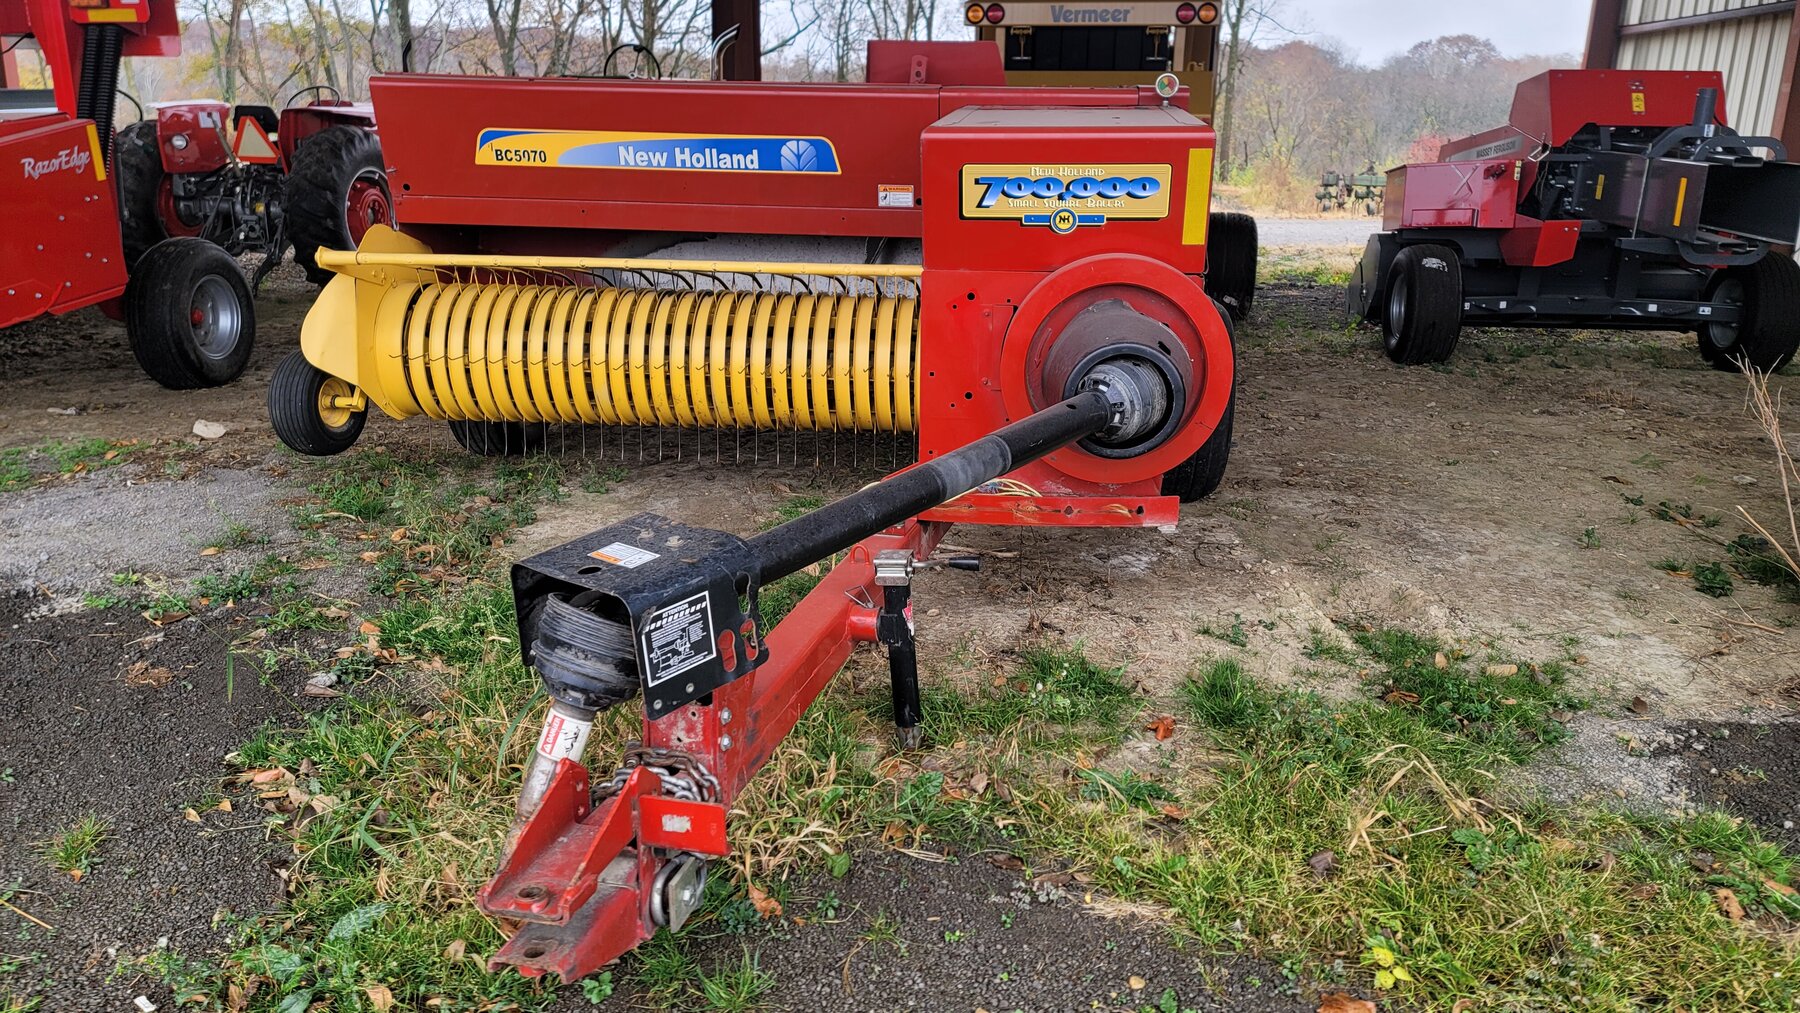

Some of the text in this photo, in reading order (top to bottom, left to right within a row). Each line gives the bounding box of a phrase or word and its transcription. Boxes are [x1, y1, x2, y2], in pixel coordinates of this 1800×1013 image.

[1050, 5, 1131, 23] Vermeer
[20, 145, 91, 180] RazorEdge
[494, 149, 547, 163] BC5070
[618, 145, 760, 170] New Holland
[974, 176, 1161, 209] 700,000
